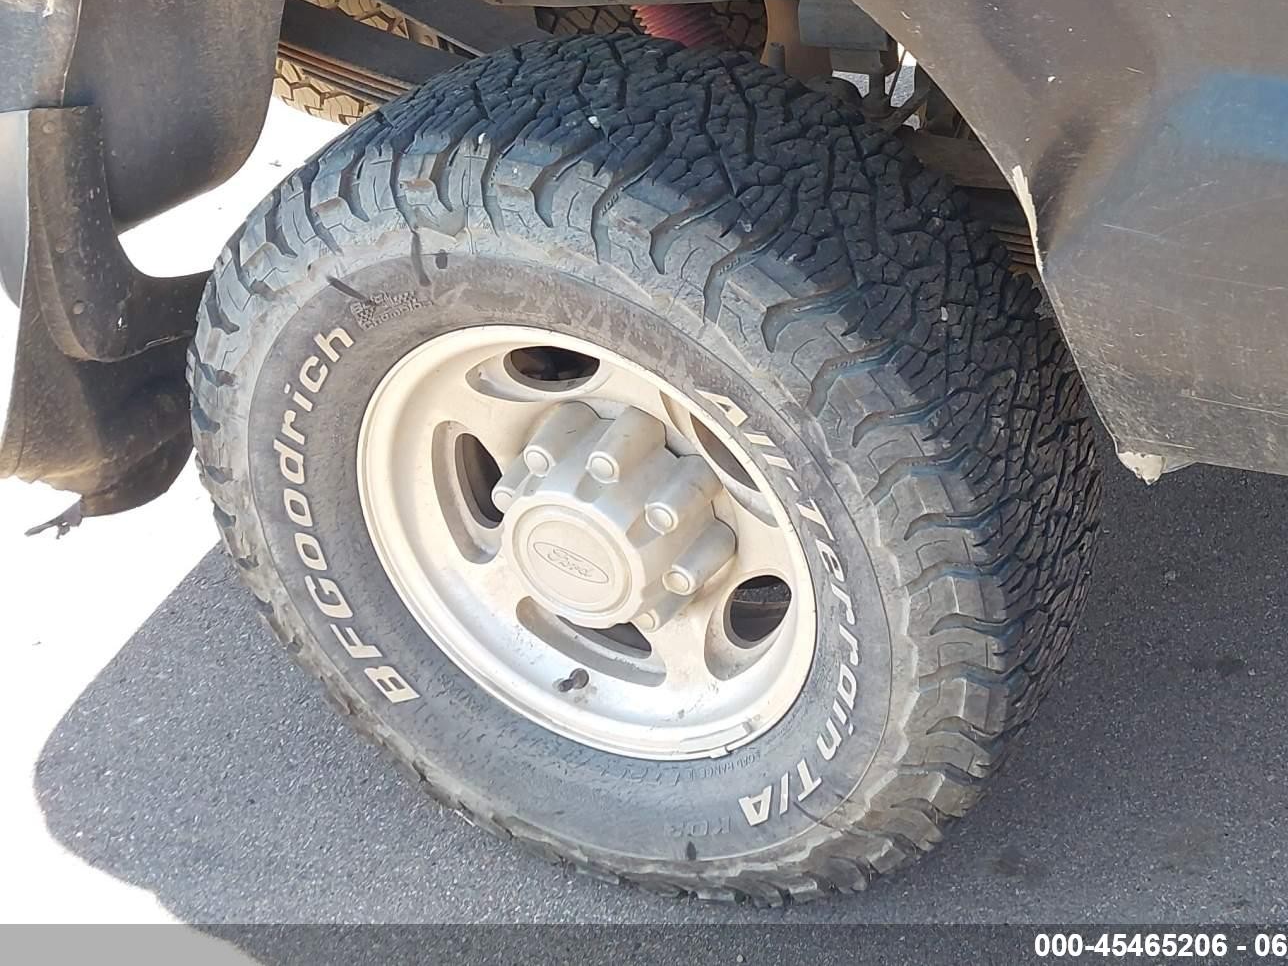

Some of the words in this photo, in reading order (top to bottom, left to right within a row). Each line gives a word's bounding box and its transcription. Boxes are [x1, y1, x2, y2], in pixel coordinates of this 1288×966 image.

[273, 326, 421, 705] BFGoodrich
[694, 388, 859, 761] All-Terrain
[738, 757, 824, 827] T/A
